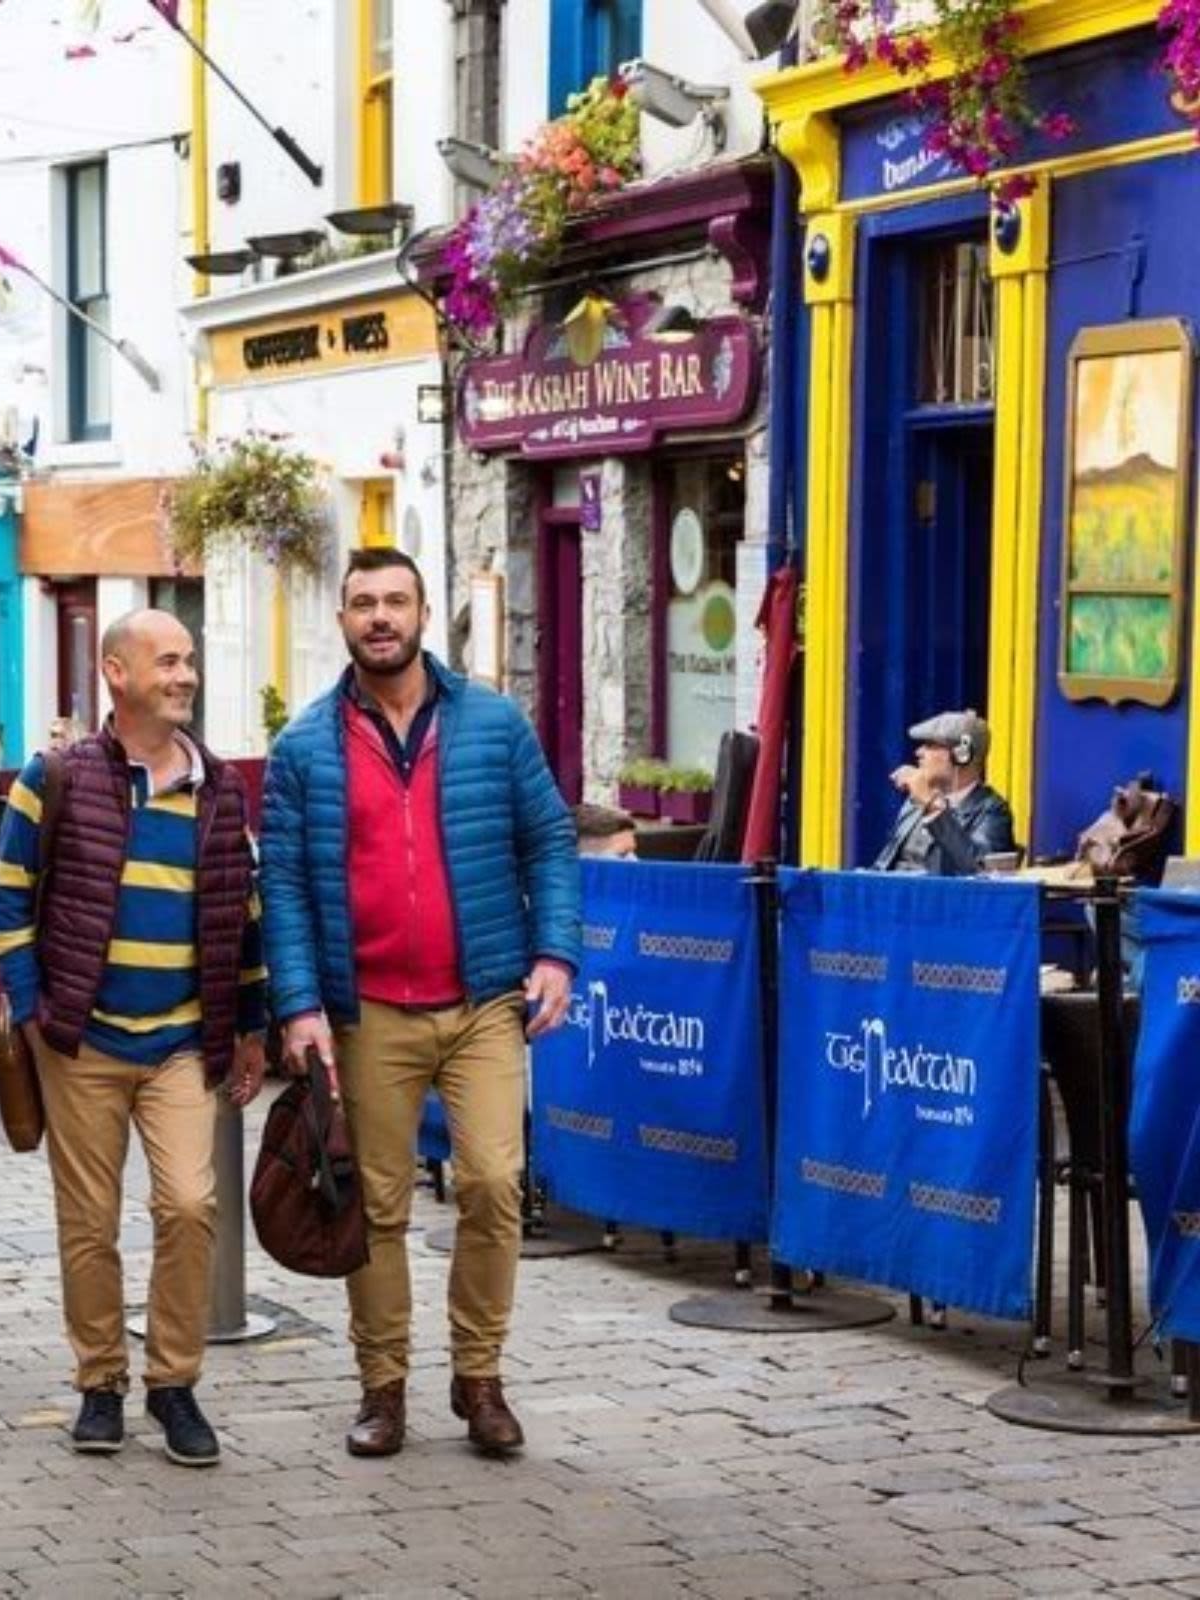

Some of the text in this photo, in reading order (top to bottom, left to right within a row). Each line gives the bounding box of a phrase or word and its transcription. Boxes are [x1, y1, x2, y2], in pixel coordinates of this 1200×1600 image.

[342, 311, 389, 353] PRESS
[517, 370, 589, 416] KASBAH
[594, 359, 652, 404] WINE
[658, 352, 704, 398] BAR
